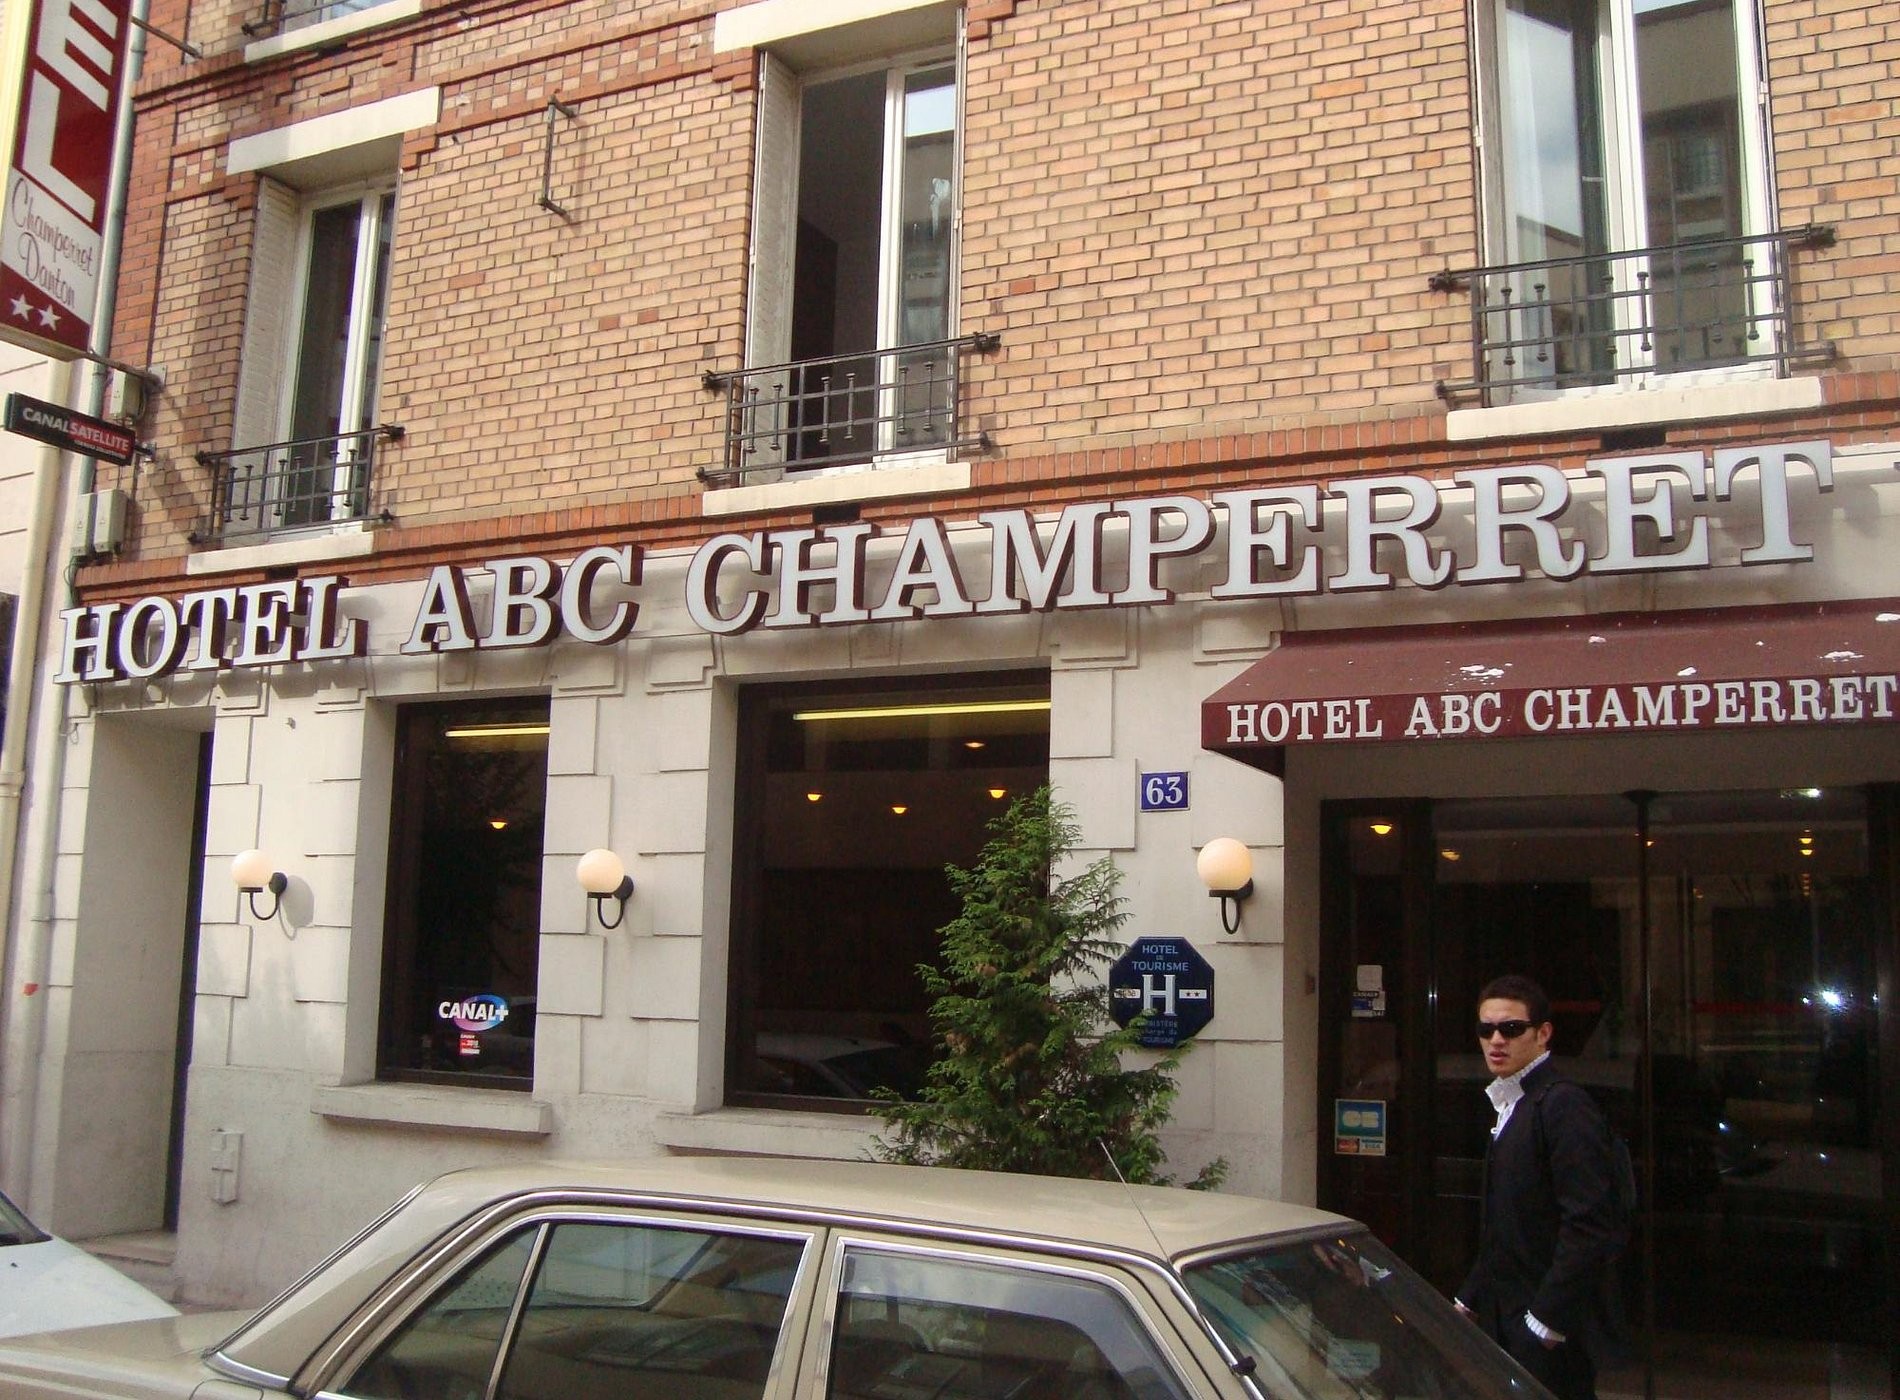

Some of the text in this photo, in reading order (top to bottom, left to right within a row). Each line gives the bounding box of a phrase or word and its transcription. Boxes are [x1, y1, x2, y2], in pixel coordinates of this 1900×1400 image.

[18, 231, 75, 309] Danton
[53, 439, 1833, 683] HOTEL ABC CHAMPERRET
[1227, 675, 1897, 743] HOTEL ABC CHAMPERRET
[1146, 776, 1183, 805] 63
[1131, 961, 1189, 971] TOURISME
[1142, 945, 1179, 954] HOTEL
[438, 1001, 509, 1022] CANAL+
[1142, 974, 1177, 1016] H
